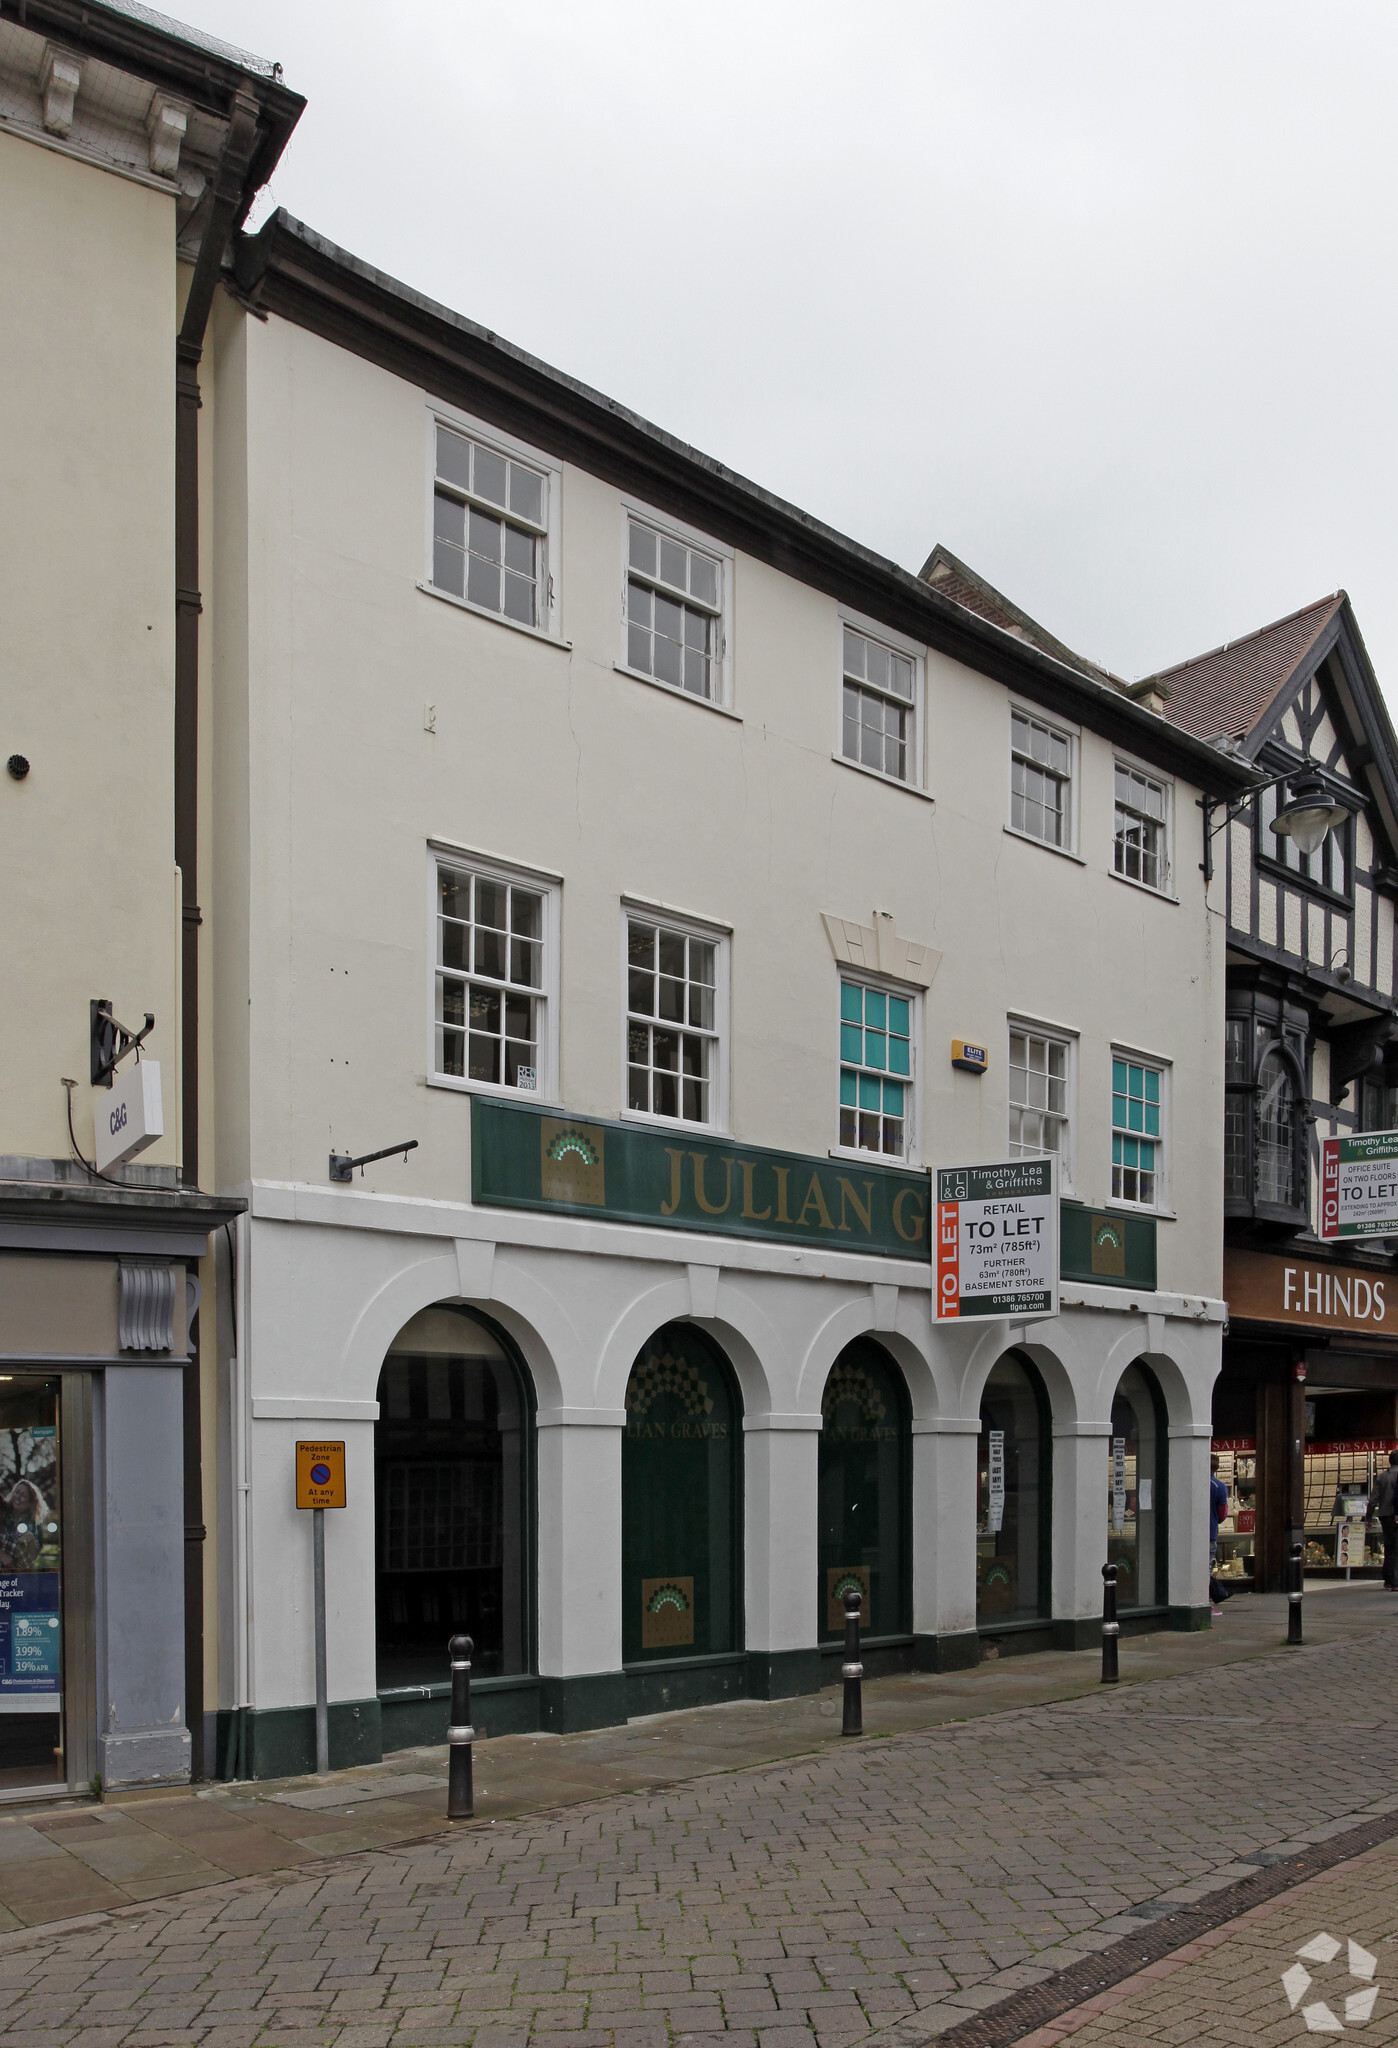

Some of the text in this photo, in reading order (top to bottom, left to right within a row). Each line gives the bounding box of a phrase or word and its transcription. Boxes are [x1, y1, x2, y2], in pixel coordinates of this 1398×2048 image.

[967, 1046, 982, 1056] ELITE
[519, 1080, 535, 1091] 2013
[110, 1102, 127, 1136] C&G
[1347, 1136, 1398, 1147] Timothy Lea
[1366, 1145, 1398, 1155] Griffiths
[971, 1166, 1043, 1180] Timothy Lea
[1348, 1163, 1391, 1173] OFFICE SUITE
[986, 1176, 1042, 1190] & Griffiths
[1343, 1173, 1396, 1184] ON TWO FLOORS
[660, 1147, 875, 1235] JULIAN
[892, 1188, 926, 1242] G
[985, 1188, 1041, 1197] COMMERCIAL
[1324, 1150, 1338, 1232] TO LET
[1341, 1184, 1398, 1201] TO LET
[983, 1203, 1025, 1215] RETAIL
[1341, 1203, 1368, 1211] EXTENDING
[965, 1217, 1045, 1239] TO LET
[969, 1240, 1041, 1255] 73m² (785ft²)
[942, 1206, 957, 1315] TO LET
[983, 1257, 1025, 1268] FURTHER
[979, 1267, 1031, 1279] 63m² (780ft²)
[965, 1278, 1045, 1291] BASEMENT STORE
[993, 1293, 1044, 1304] 01386 765700
[1283, 1267, 1386, 1321] F.HINDS
[1010, 1302, 1045, 1312] tlgea.com
[670, 1422, 728, 1439] GRAVES
[300, 1444, 342, 1452] Pedestrian
[1213, 1439, 1249, 1450] SALE
[1354, 1440, 1387, 1451] SALE
[311, 1453, 331, 1461] Zone
[308, 1488, 334, 1497] At any
[312, 1497, 330, 1505] time
[11, 1578, 18, 1587] of
[15, 1626, 42, 1637] 1.89%
[15, 1646, 42, 1657] 3.99%
[15, 1661, 36, 1672] 3.9%
